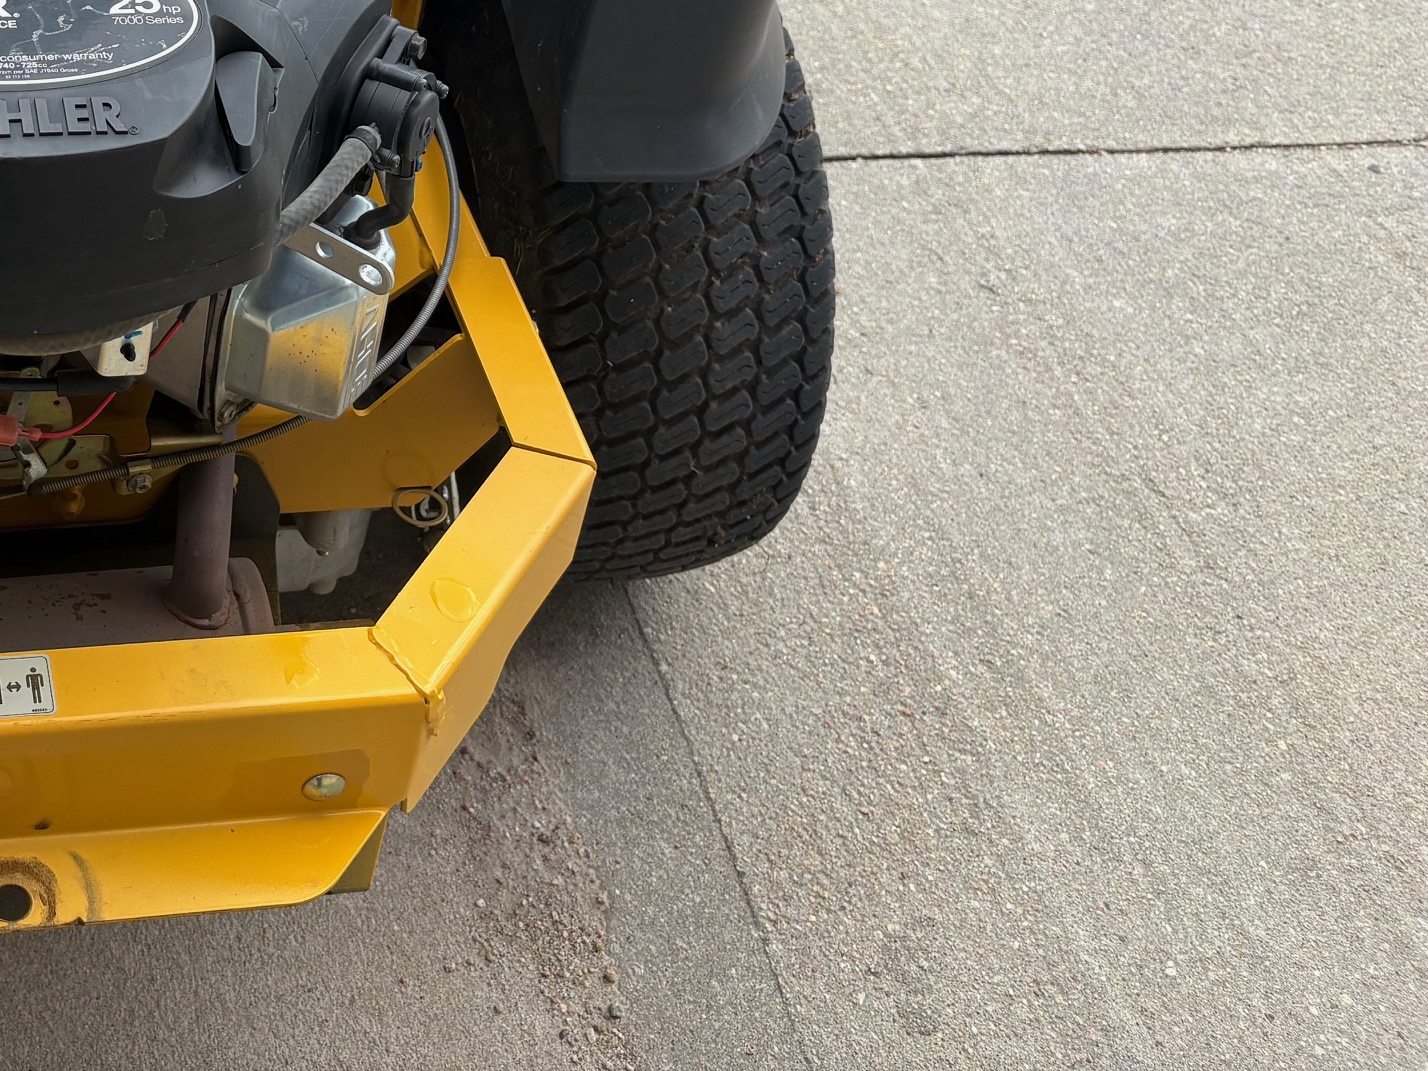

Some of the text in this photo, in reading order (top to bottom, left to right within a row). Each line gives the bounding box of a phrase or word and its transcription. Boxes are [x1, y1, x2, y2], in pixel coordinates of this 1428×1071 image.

[162, 5, 182, 15] hp
[112, 15, 184, 25] 7000 Series
[0, 53, 59, 63] consumer
[62, 51, 114, 61] warranty
